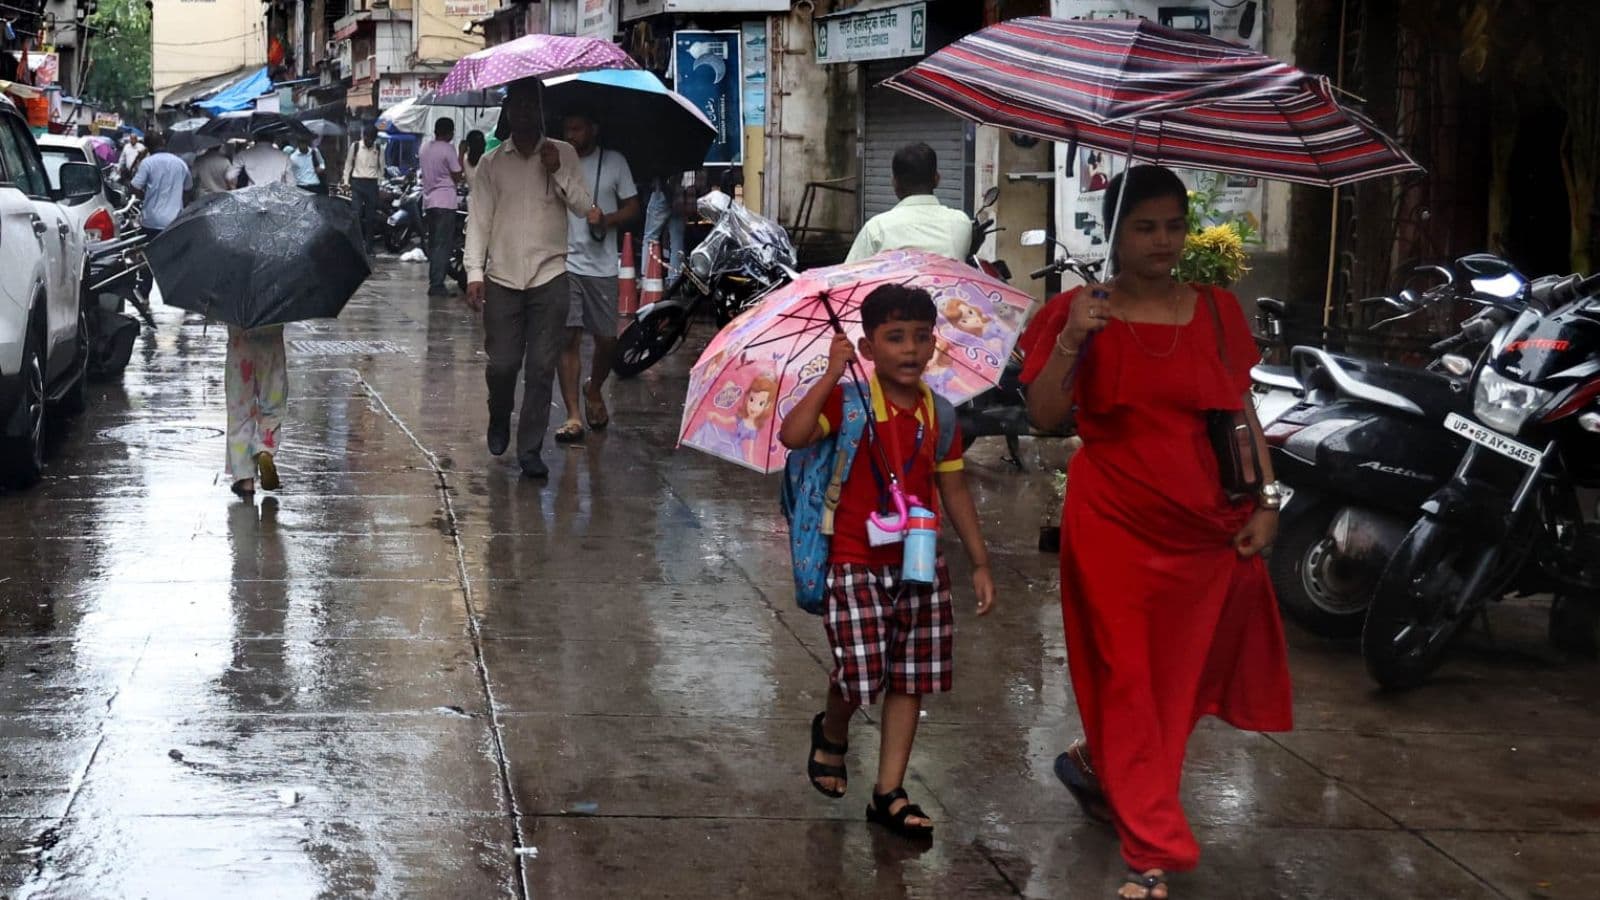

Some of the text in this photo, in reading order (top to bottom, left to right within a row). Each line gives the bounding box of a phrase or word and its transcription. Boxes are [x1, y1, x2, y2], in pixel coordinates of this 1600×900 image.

[1453, 420, 1537, 463] UP 62 AY 3455
